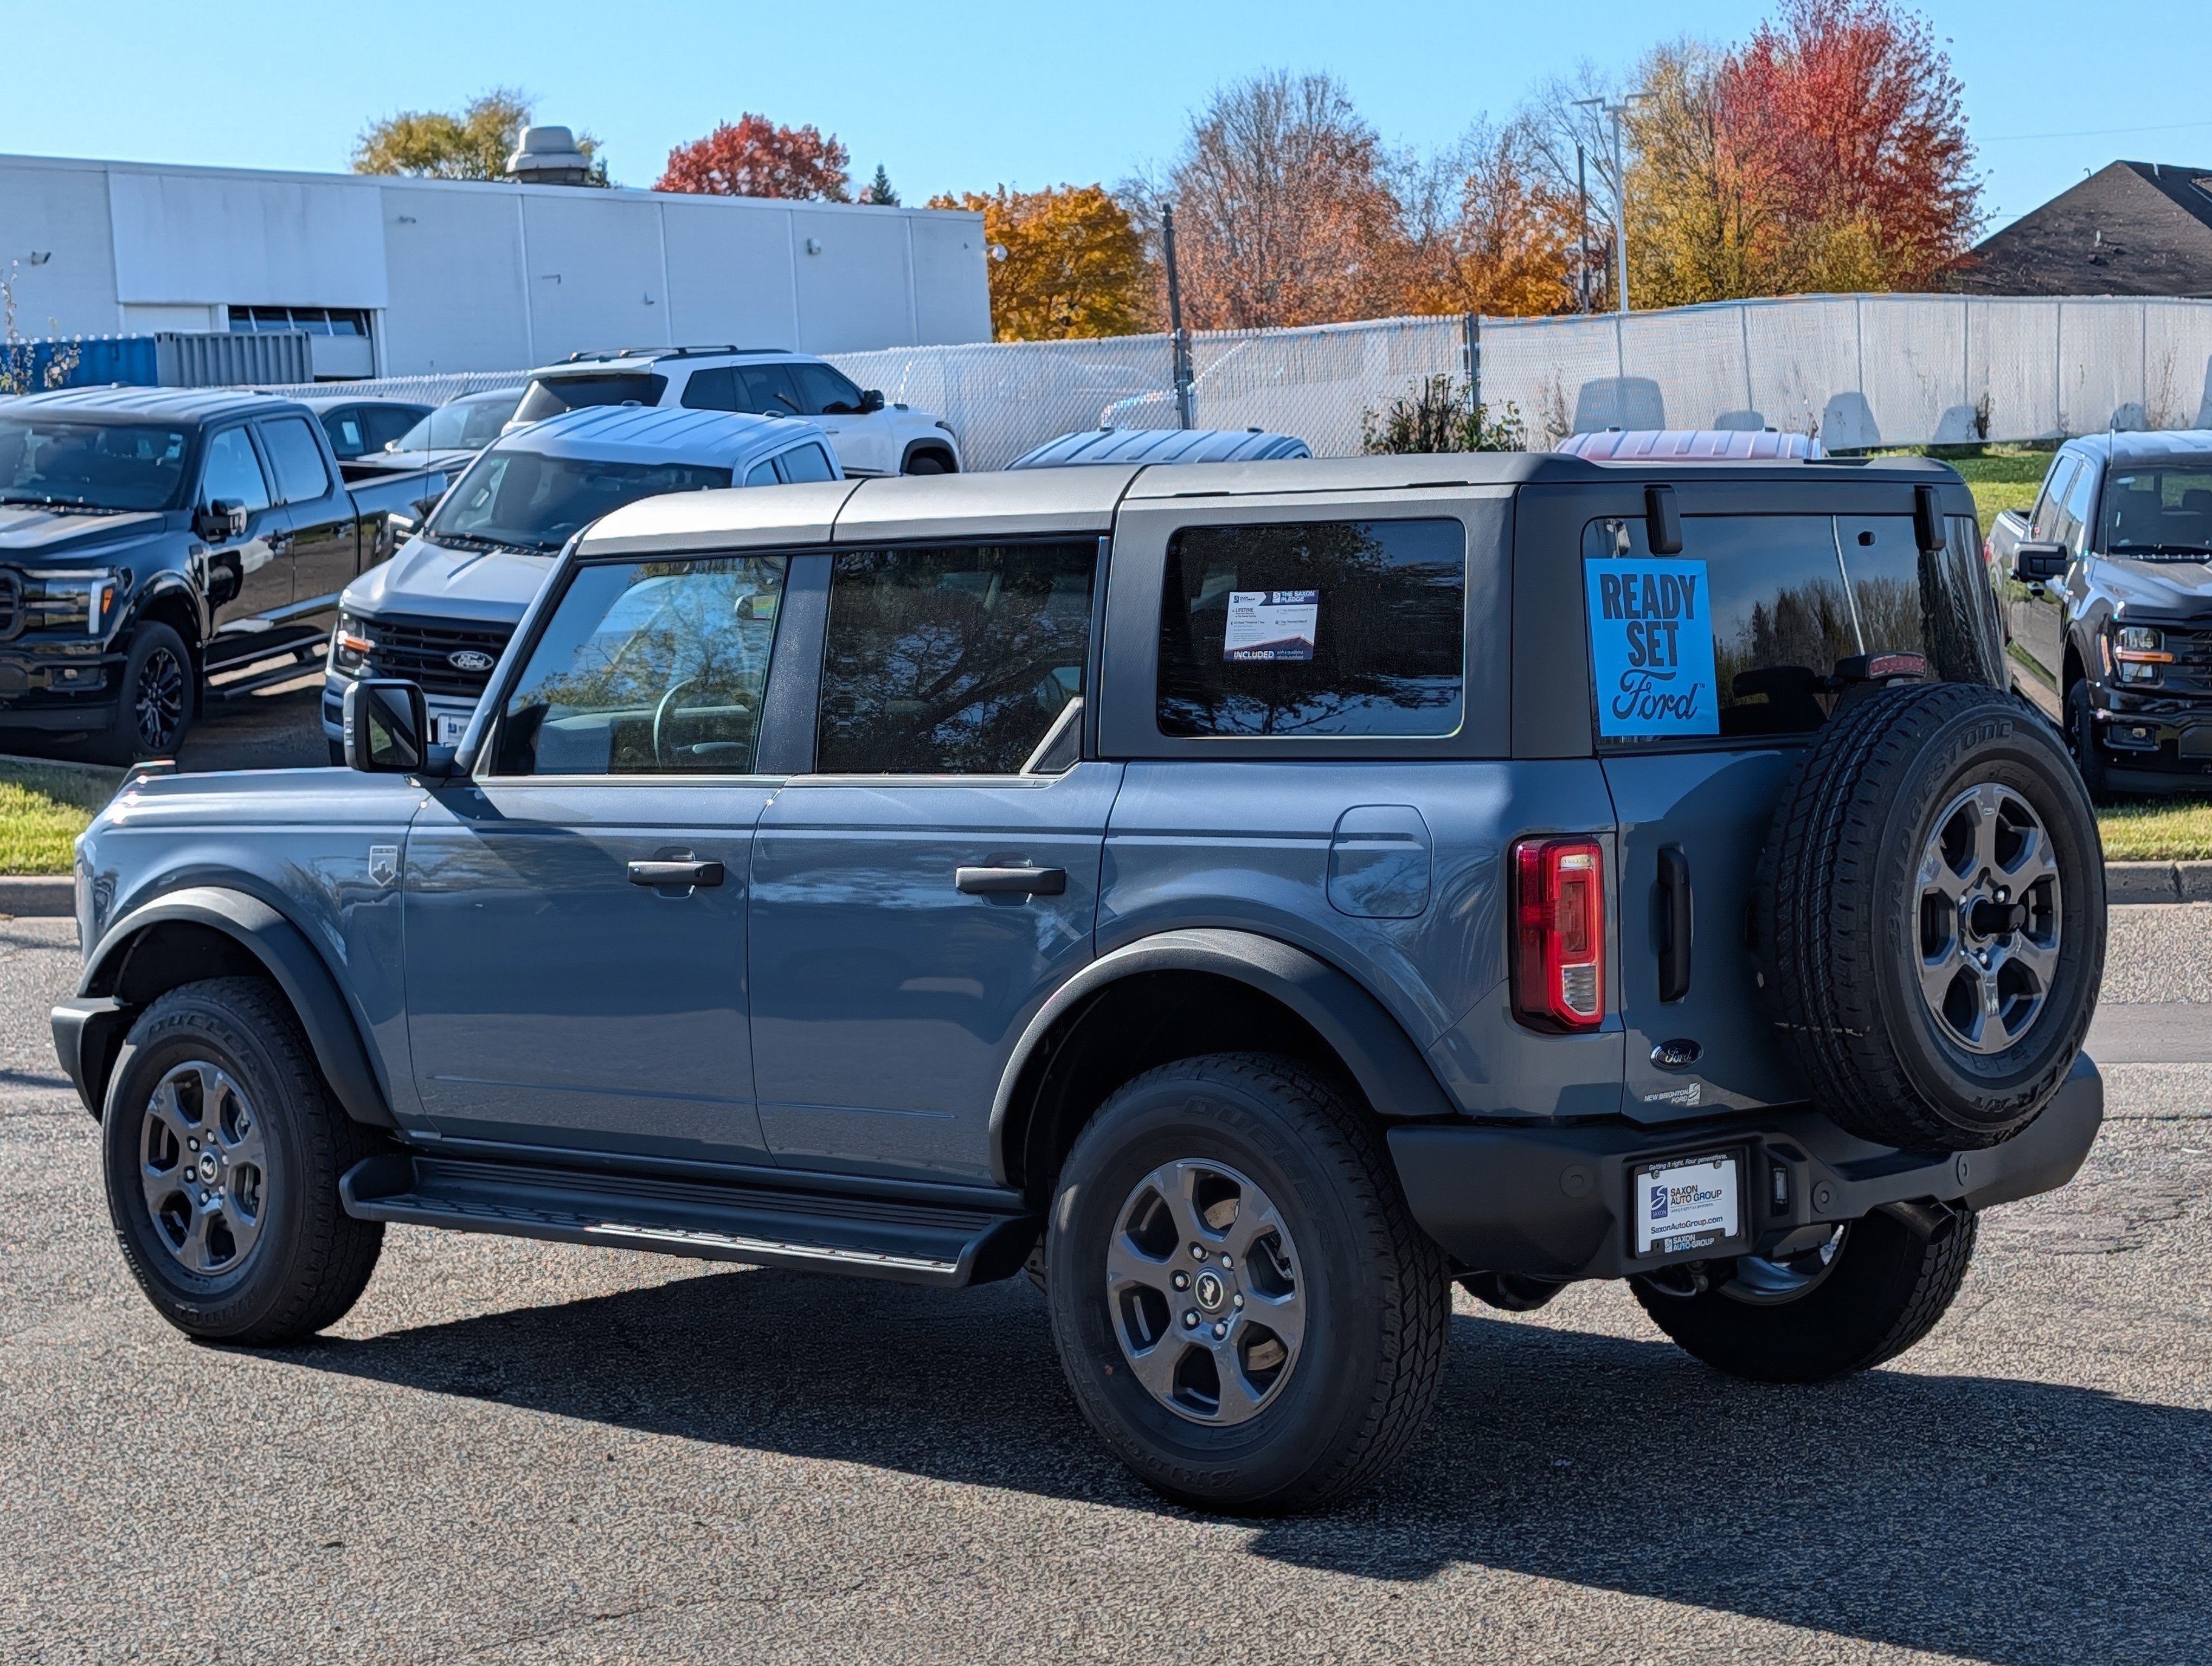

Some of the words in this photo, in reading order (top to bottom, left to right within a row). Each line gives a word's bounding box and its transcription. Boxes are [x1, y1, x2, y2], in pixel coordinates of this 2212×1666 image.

[1599, 573, 1696, 619] READY
[1626, 621, 1679, 667] SET
[1612, 669, 1698, 720] Ford
[1665, 1047, 1692, 1063] Ford
[1644, 1093, 1658, 1101] NEW
[1658, 1088, 1689, 1100] BRIGHTON
[1649, 1163, 1667, 1171] Getting
[1671, 1159, 1684, 1168] right.
[1697, 1154, 1728, 1164] generations.
[1670, 1184, 1698, 1197] SAXON
[1670, 1195, 1692, 1206] AUTO
[1693, 1189, 1722, 1201] GROUP
[1651, 1216, 1723, 1234] SaxonAutoGroup.com
[1673, 1234, 1696, 1244] SAXON
[1673, 1242, 1689, 1252] AUTO
[1691, 1238, 1714, 1247] GROUP
